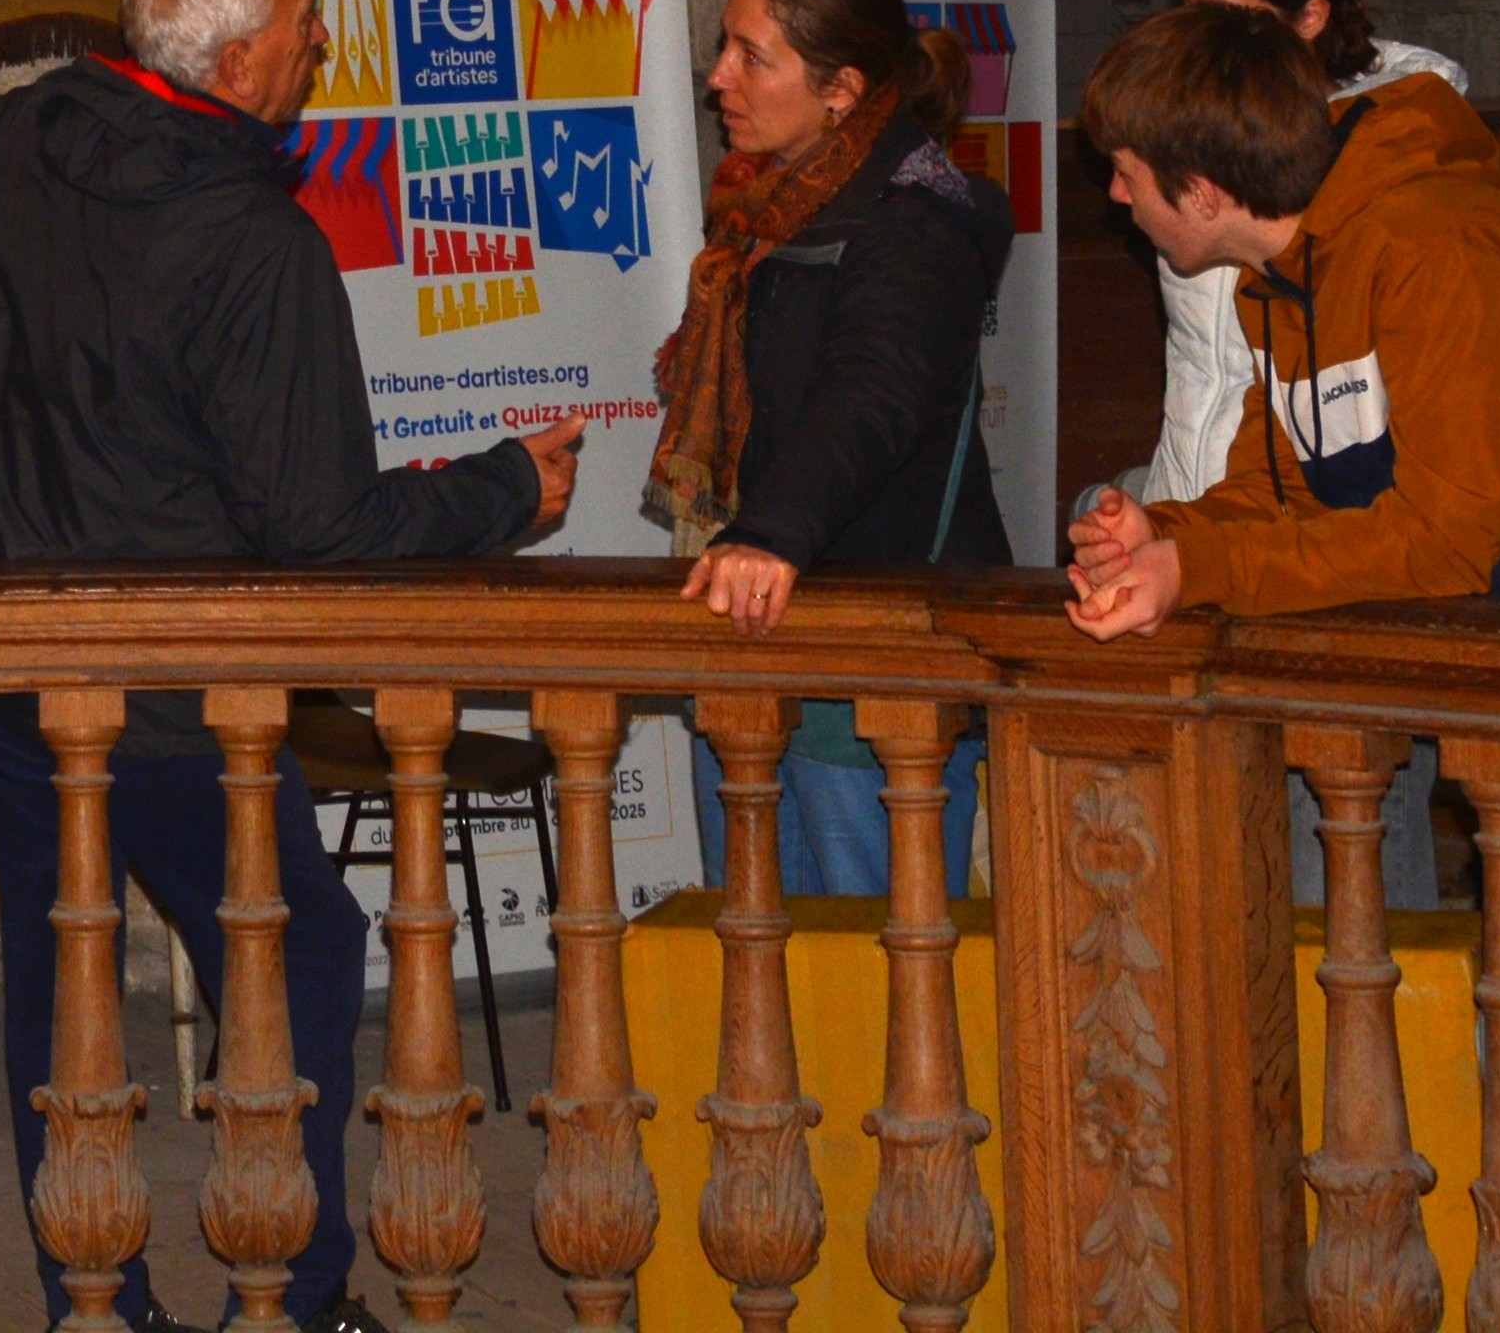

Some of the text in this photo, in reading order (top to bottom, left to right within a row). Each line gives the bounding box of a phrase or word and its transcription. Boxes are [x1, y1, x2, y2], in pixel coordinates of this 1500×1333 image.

[431, 48, 496, 66] tribune
[415, 67, 498, 87] d'artistes
[370, 365, 590, 394] tribune-dartistes.org
[394, 408, 475, 439] Gratuit
[479, 413, 498, 430] et
[502, 404, 563, 430] Quizz
[568, 397, 659, 429] surprise
[371, 826, 393, 845] du
